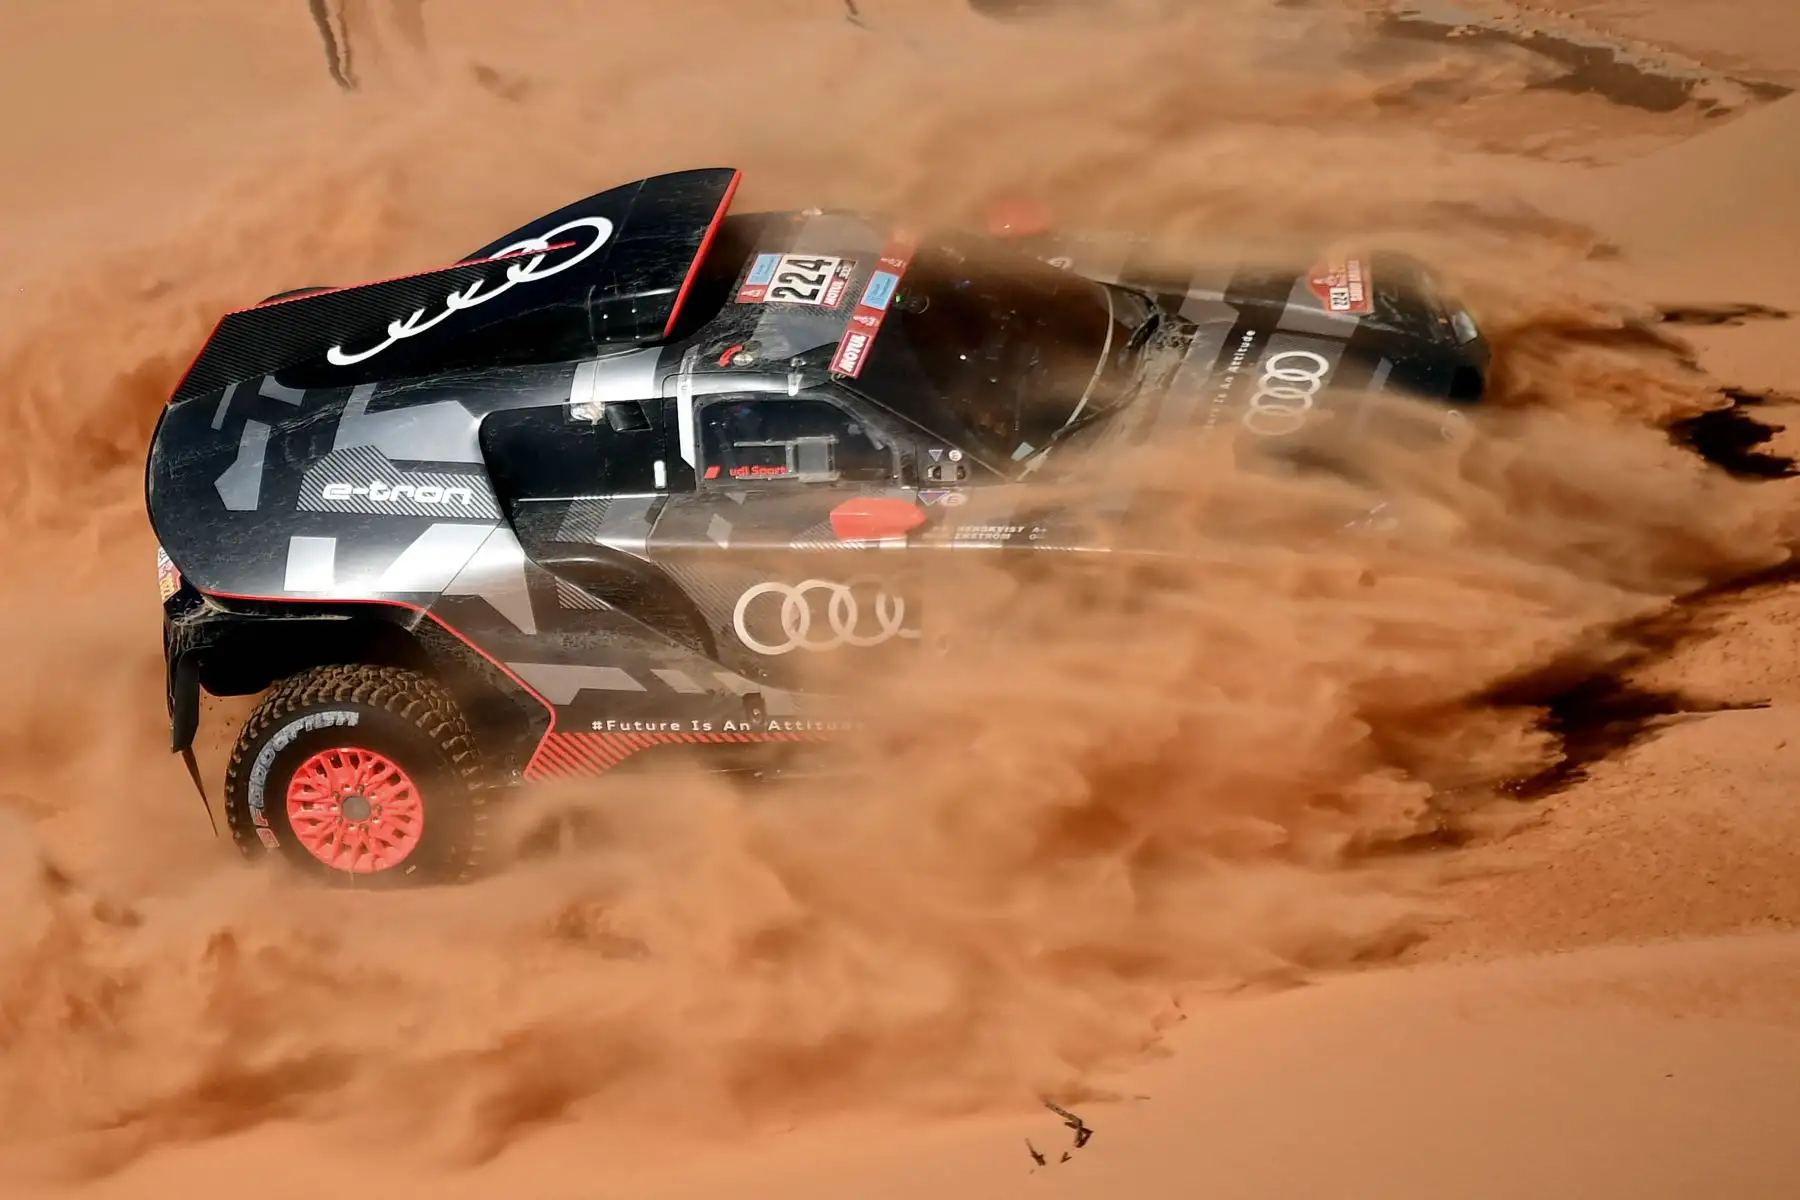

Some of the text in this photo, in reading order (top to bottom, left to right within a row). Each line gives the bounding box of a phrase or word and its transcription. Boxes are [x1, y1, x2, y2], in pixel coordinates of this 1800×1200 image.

[771, 259, 832, 301] 224
[823, 280, 844, 306] MOTUL
[1334, 291, 1349, 307] 224
[838, 334, 868, 373] MOTUL
[1228, 329, 1256, 373] Attitude
[751, 465, 788, 476] Sport
[322, 480, 472, 506] e-tron
[591, 719, 682, 732] #Future
[691, 719, 713, 732] Is
[723, 719, 751, 732] An
